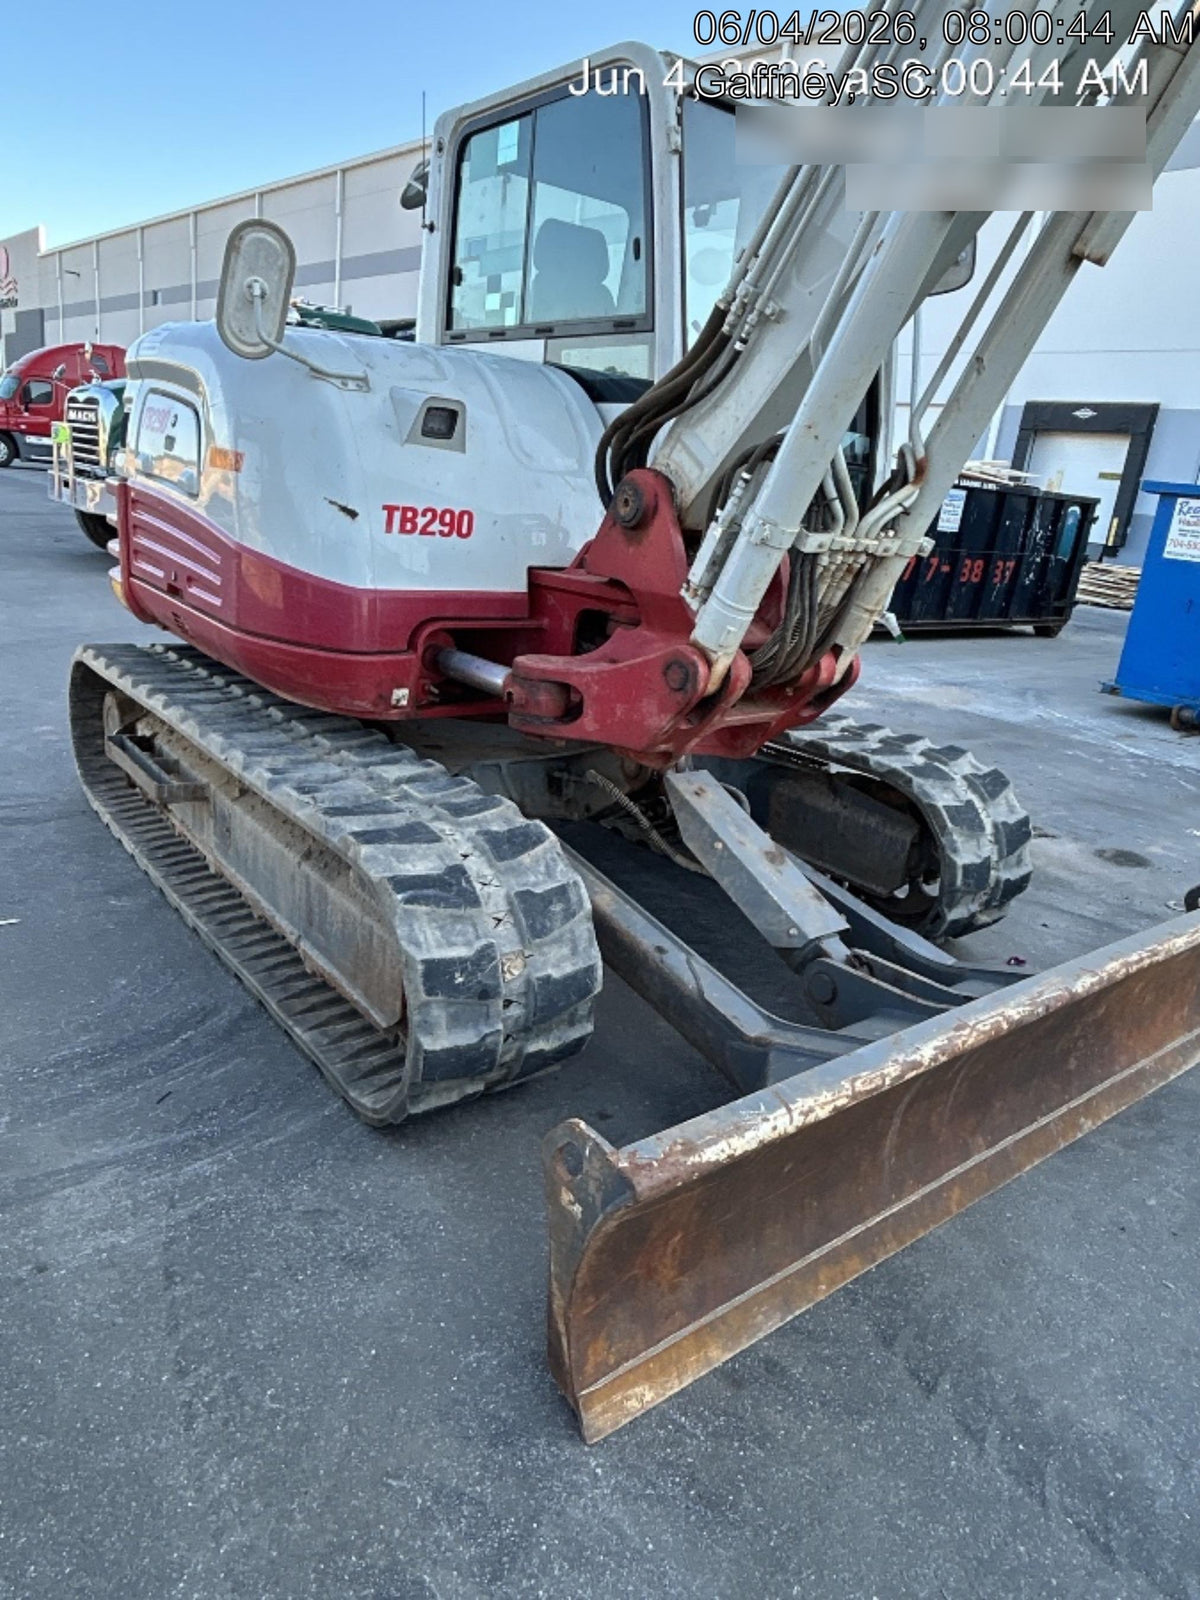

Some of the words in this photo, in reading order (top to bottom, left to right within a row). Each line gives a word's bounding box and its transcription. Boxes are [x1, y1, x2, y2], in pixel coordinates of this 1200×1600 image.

[382, 504, 475, 540] TB290
[959, 558, 985, 582] 38
[992, 560, 1016, 583] 37
